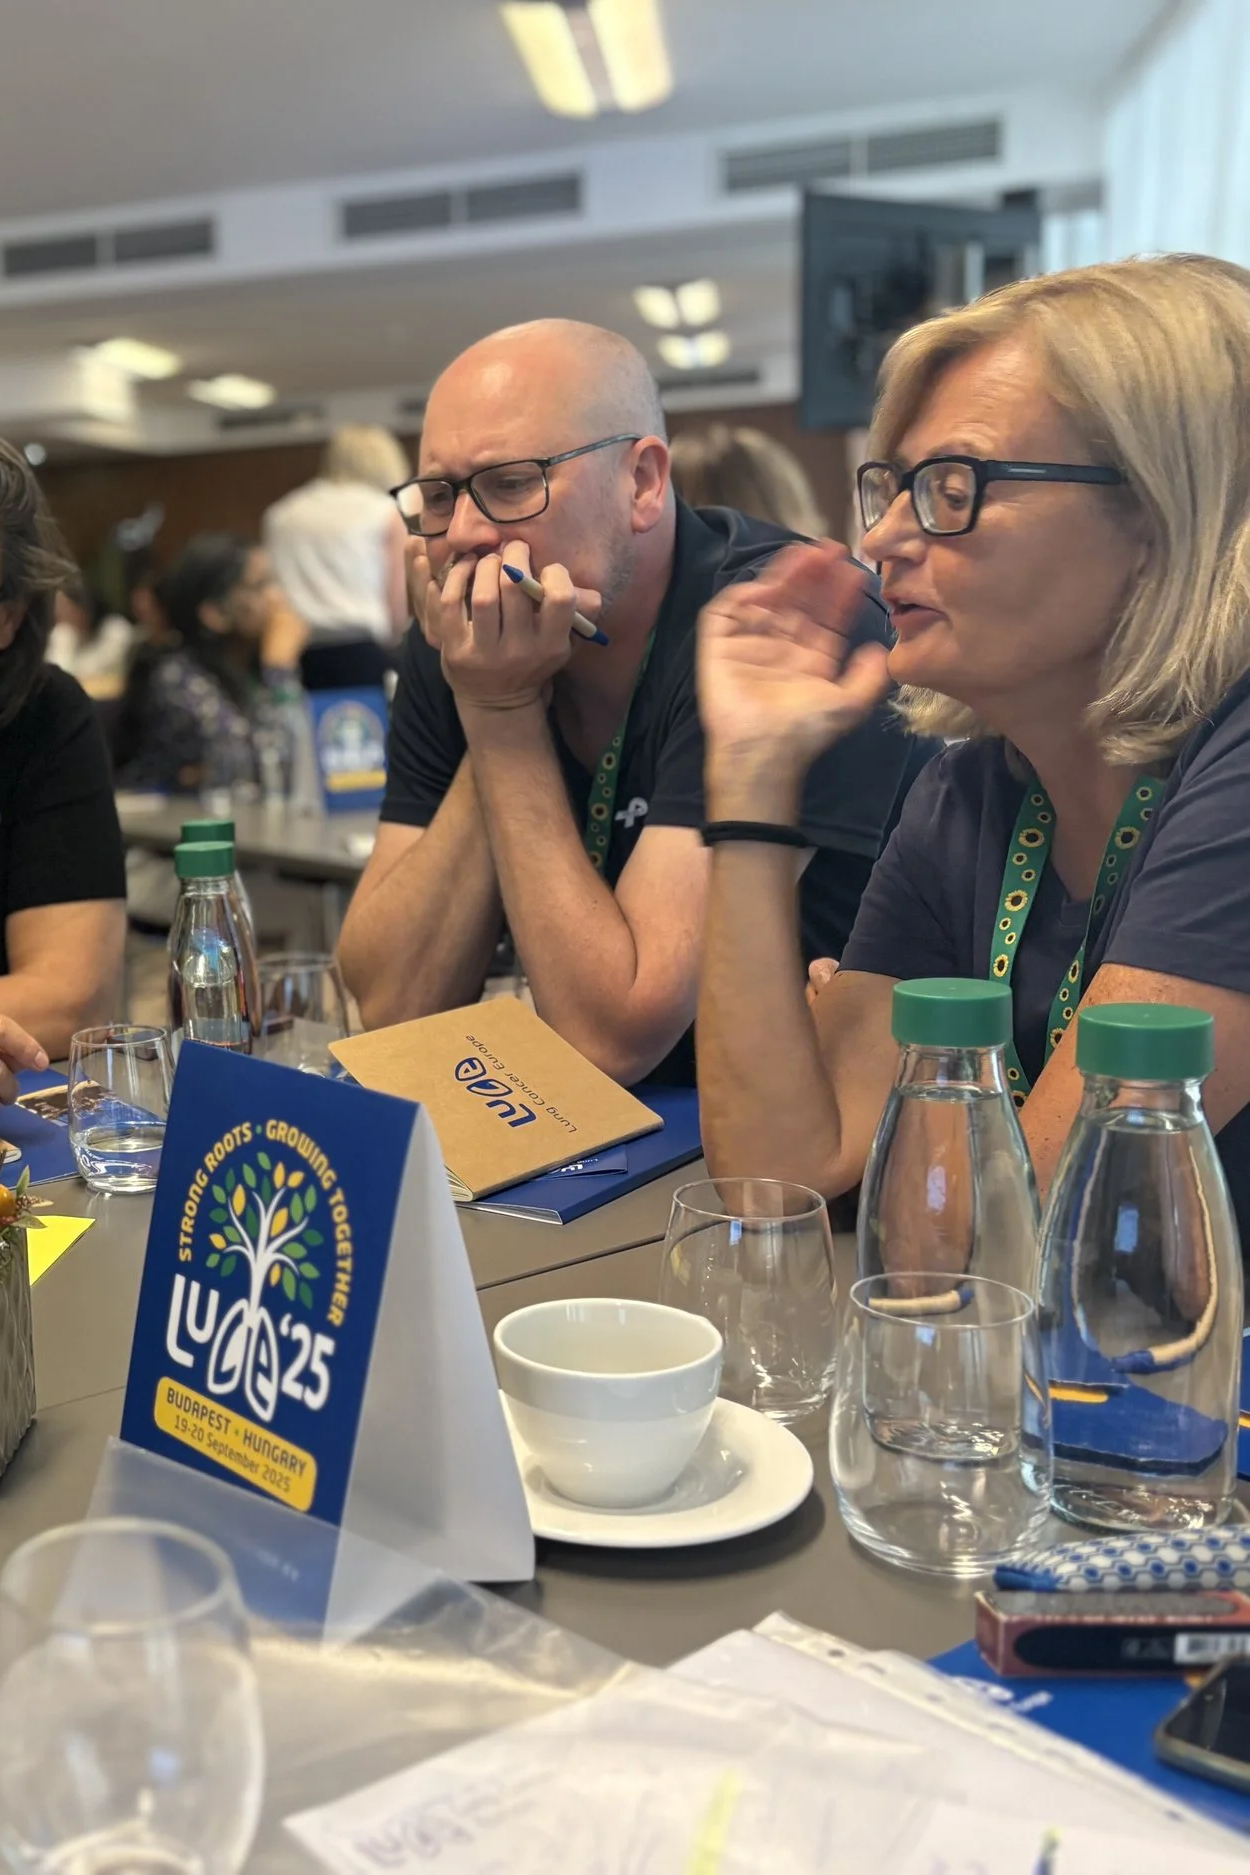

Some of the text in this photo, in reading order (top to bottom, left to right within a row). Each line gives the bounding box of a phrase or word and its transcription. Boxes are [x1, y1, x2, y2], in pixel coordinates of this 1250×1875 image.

[465, 1034, 578, 1134] Lung Cancer Europe
[176, 1119, 355, 1328] STRONG ROOTS GROWING TOGETHER
[166, 1386, 307, 1479] BUDAPEST HUNGARY
[173, 1414, 292, 1494] 19-20 September 2025
